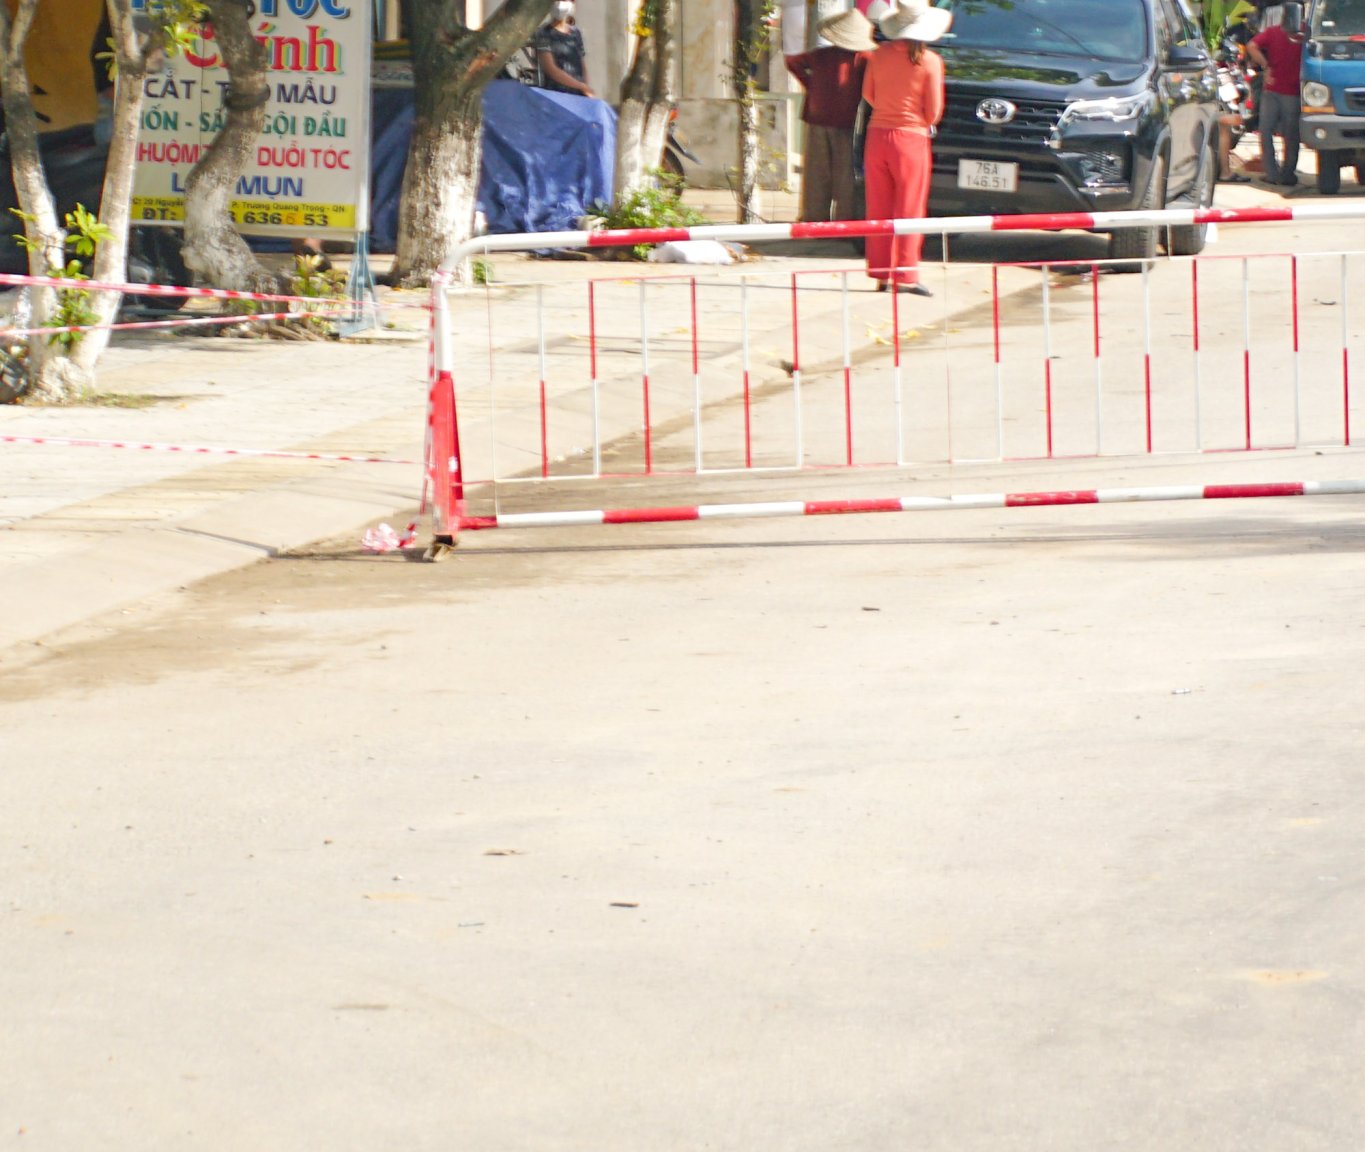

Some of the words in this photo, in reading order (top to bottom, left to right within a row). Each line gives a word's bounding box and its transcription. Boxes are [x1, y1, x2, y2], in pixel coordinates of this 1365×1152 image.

[184, 21, 341, 73] Cính
[144, 68, 196, 99] CẮT
[276, 76, 336, 105] MẪU
[141, 104, 178, 131] ỐN
[303, 110, 346, 137] ĐẦU
[136, 138, 199, 166] HUỘM
[311, 144, 351, 170] TÓC
[975, 161, 999, 175] 76A
[236, 175, 303, 199] MỤN
